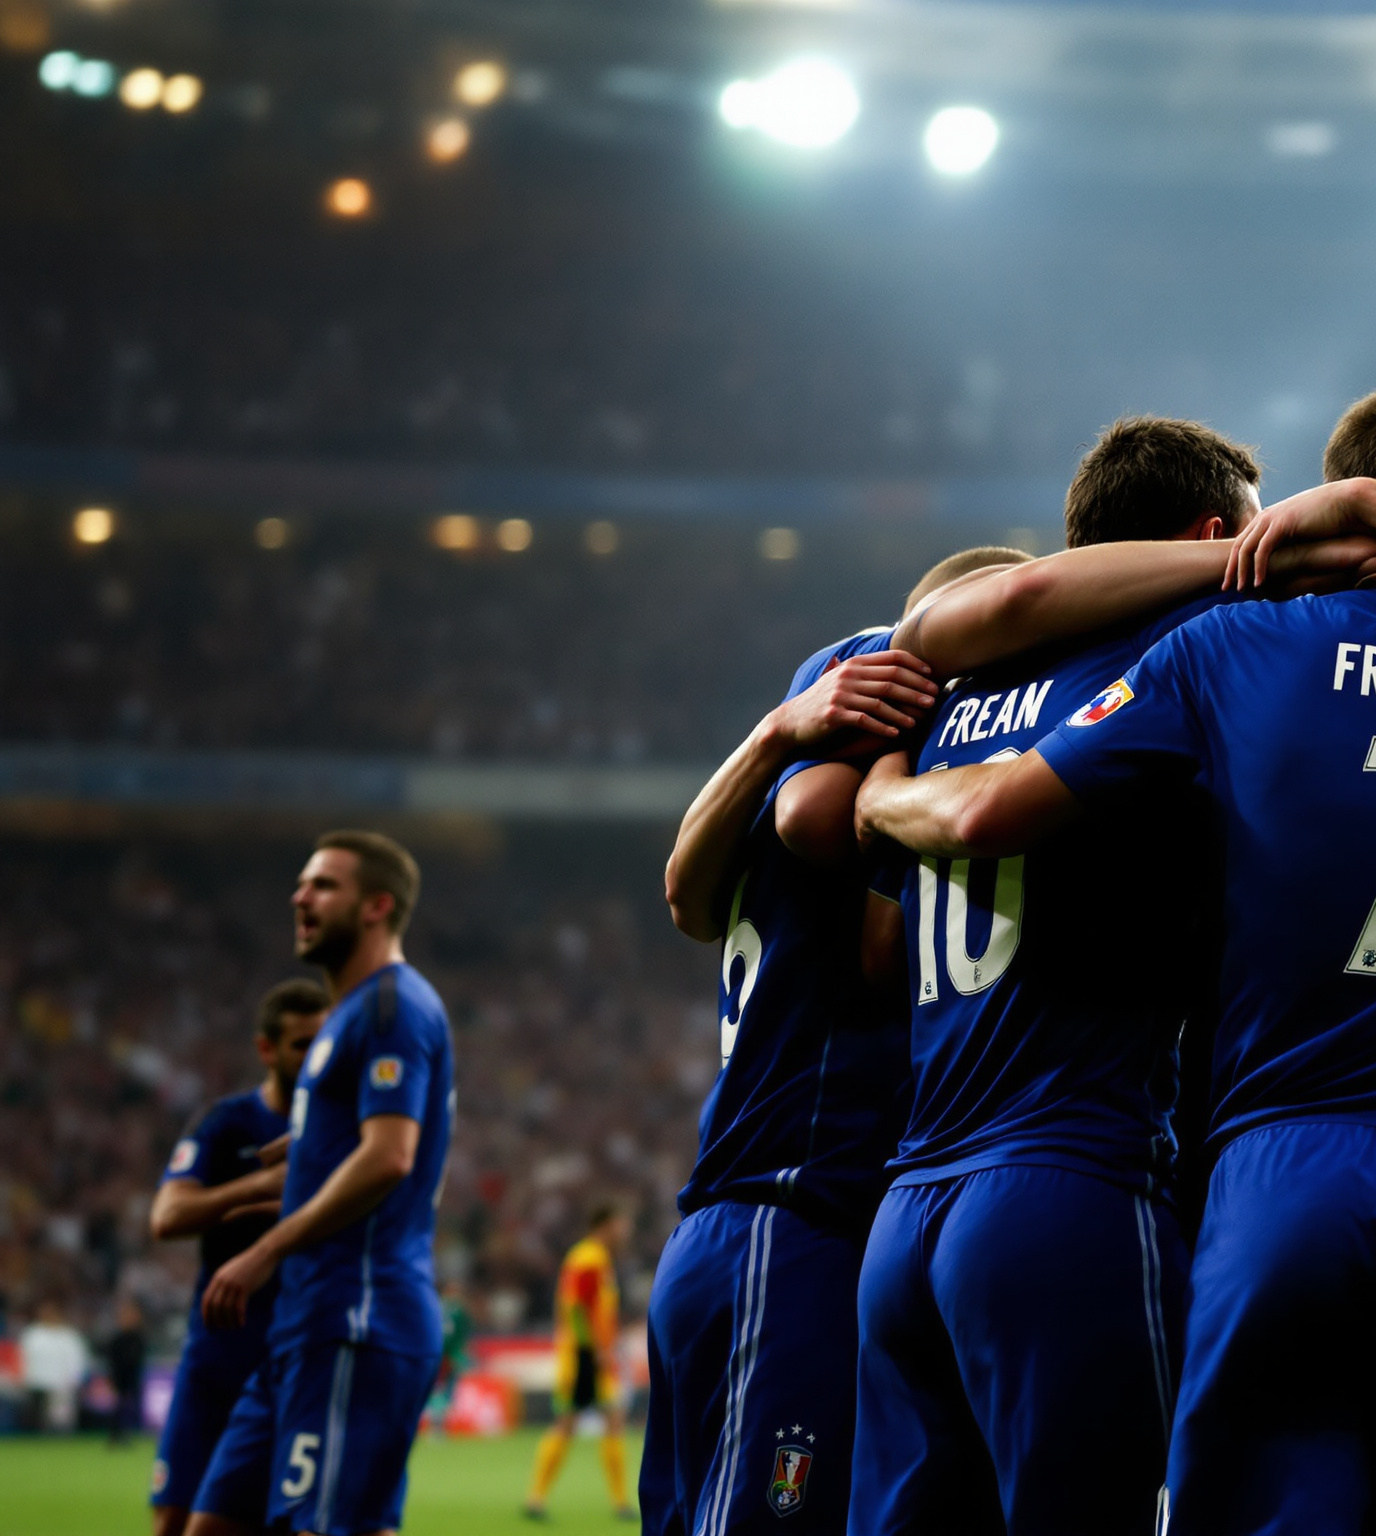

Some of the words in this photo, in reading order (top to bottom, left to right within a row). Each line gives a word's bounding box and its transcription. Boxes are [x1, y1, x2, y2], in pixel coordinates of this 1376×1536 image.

[938, 680, 1054, 747] FREAM
[918, 747, 1025, 1005] 10
[281, 1433, 320, 1498] 5
